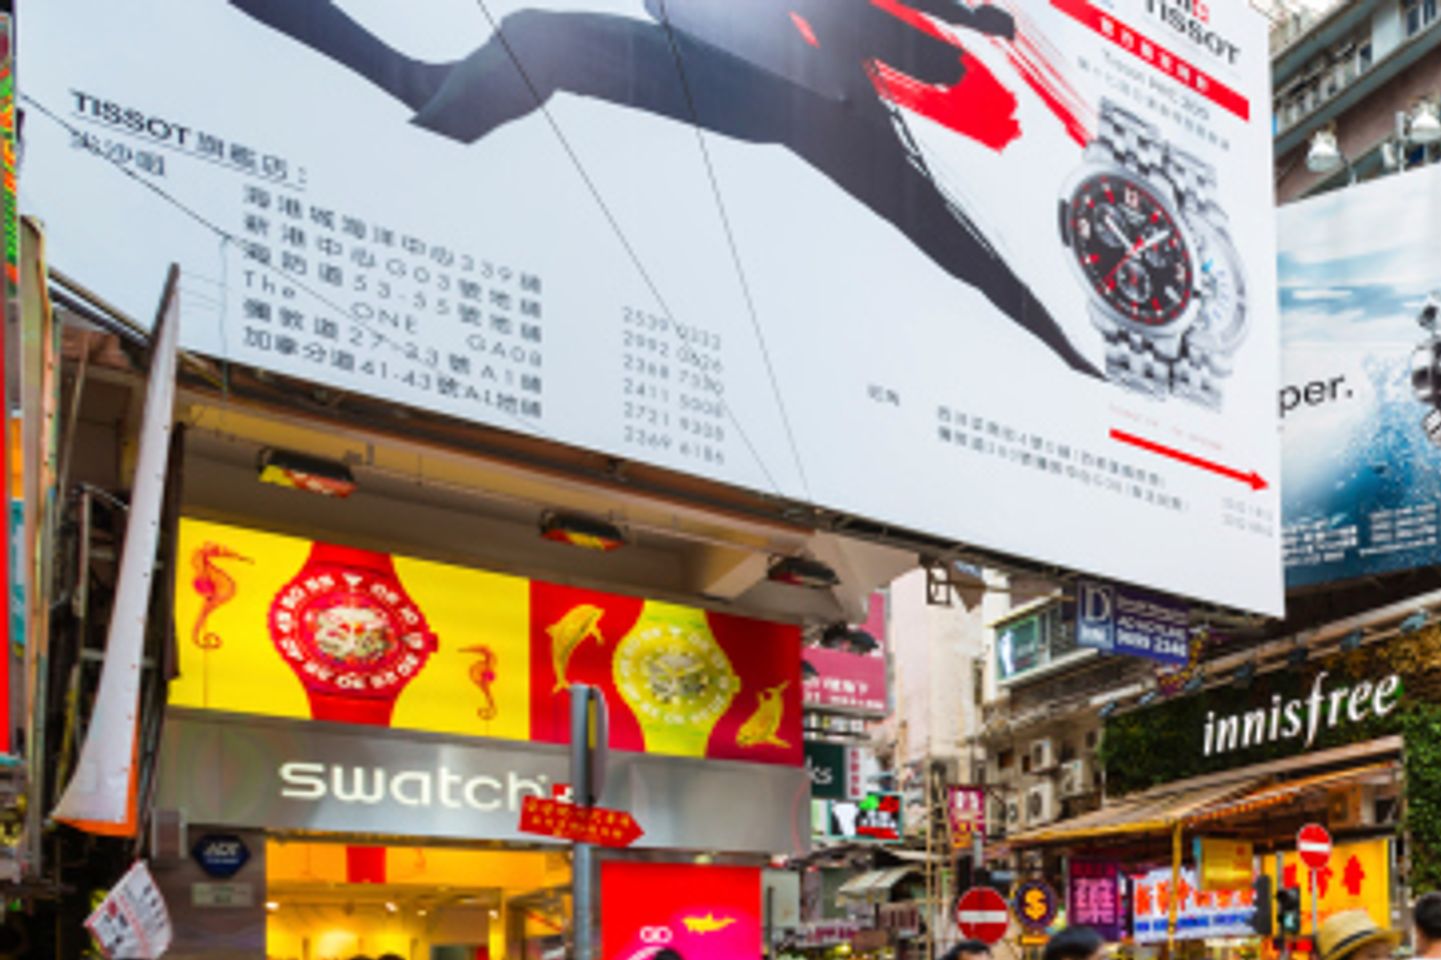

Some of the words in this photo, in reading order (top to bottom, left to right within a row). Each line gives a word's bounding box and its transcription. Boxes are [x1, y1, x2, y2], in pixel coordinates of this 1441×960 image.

[68, 88, 191, 145] TISSOT
[243, 270, 296, 299] The
[351, 302, 418, 335] ONE
[1279, 374, 1353, 419] per.
[1203, 671, 1400, 757] innisfree
[278, 760, 546, 814] swatch
